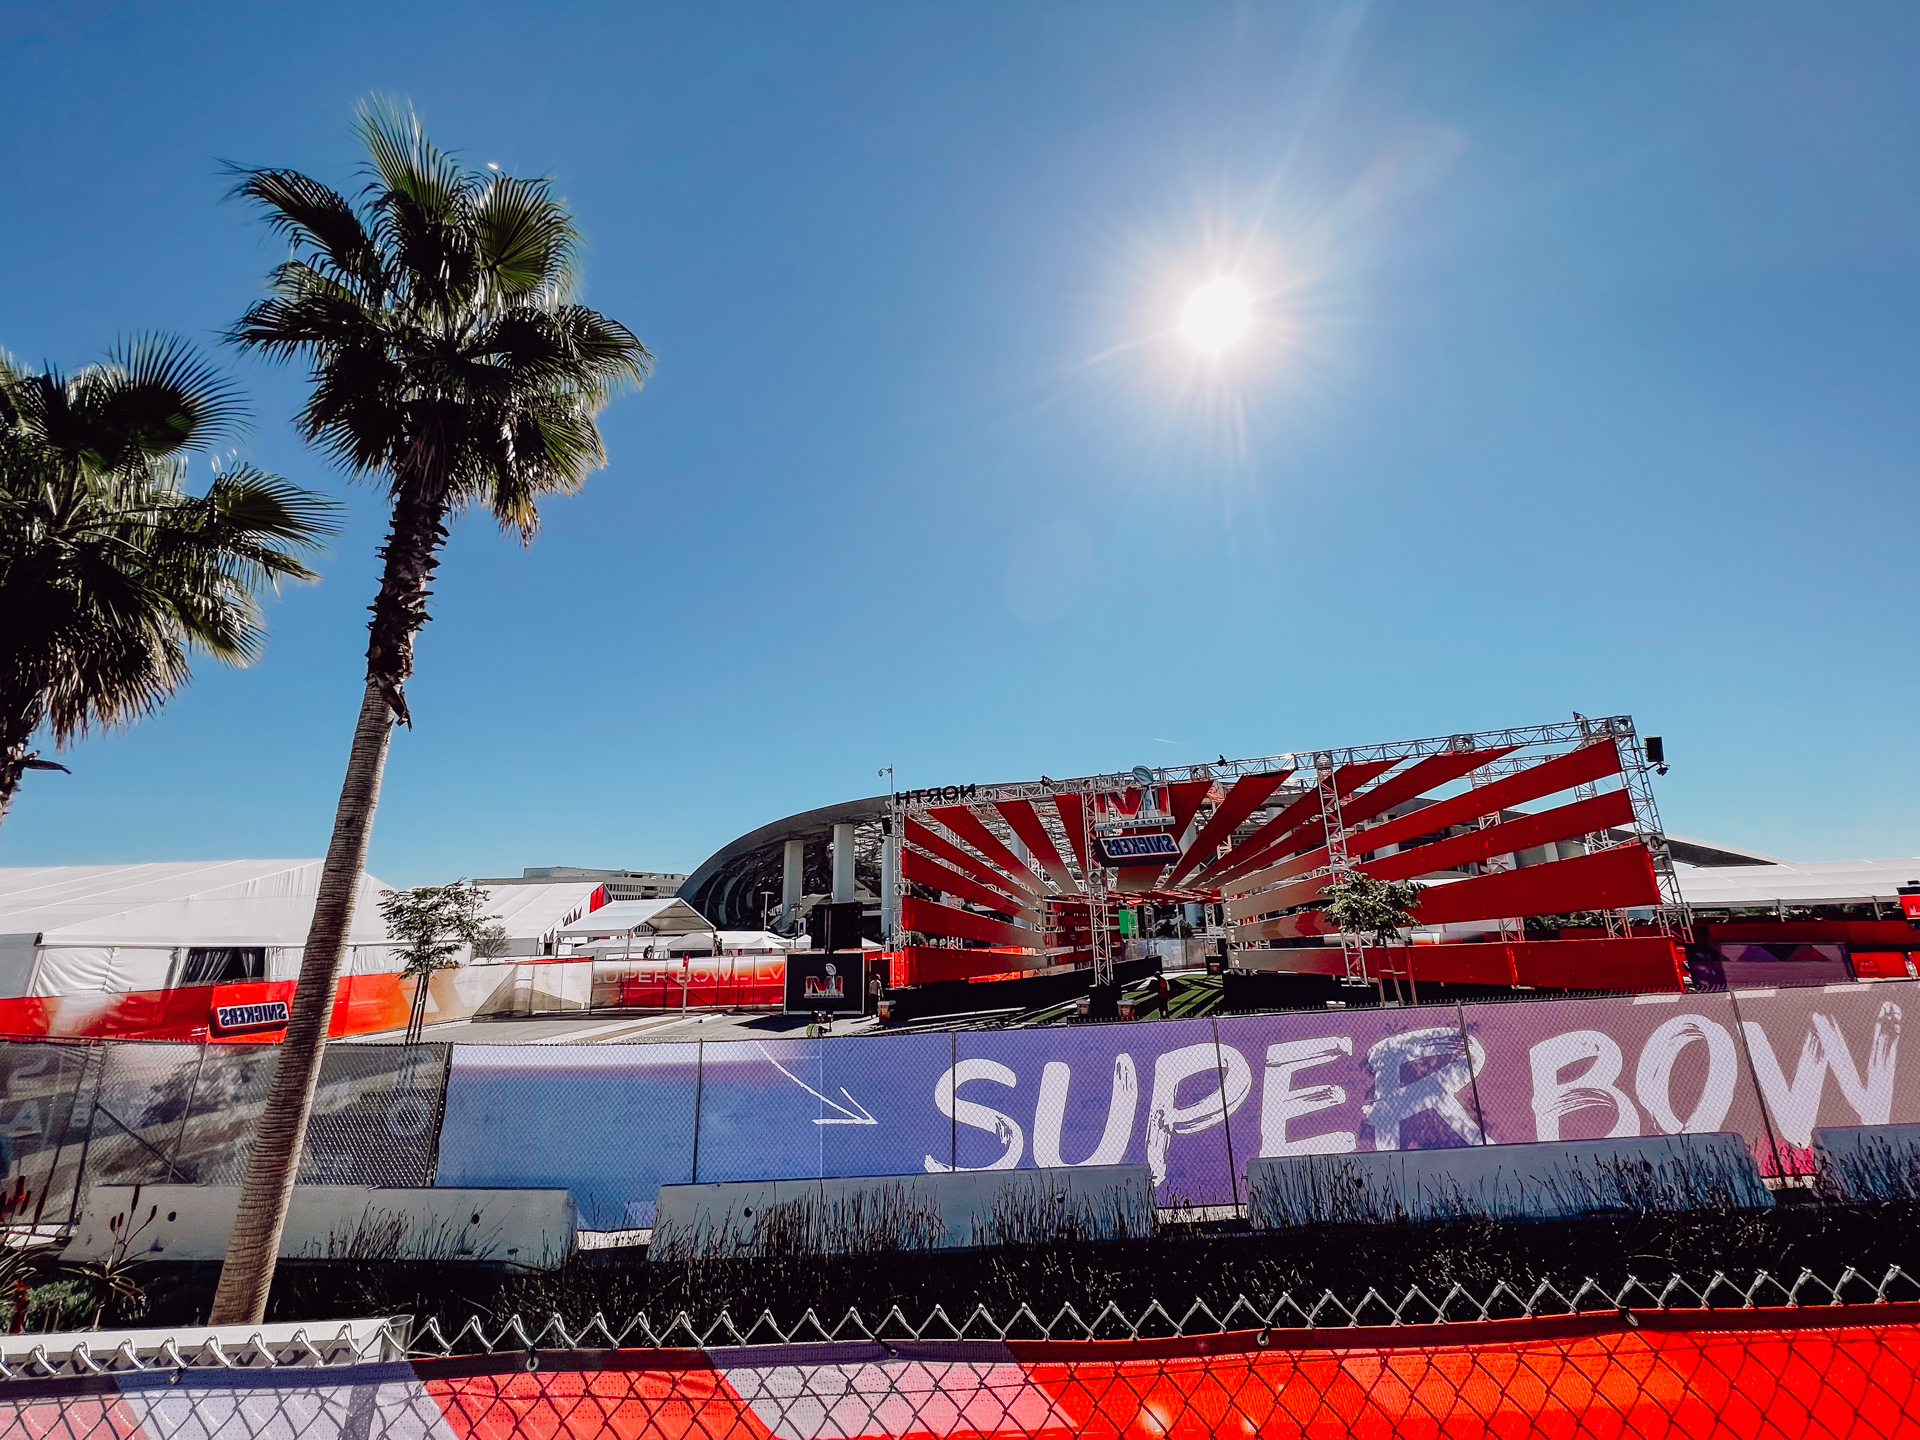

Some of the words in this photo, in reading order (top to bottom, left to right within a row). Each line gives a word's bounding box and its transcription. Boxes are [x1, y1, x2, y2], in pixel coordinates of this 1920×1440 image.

[593, 969, 669, 985] SUPER
[677, 967, 750, 984] BOWL
[924, 1027, 1497, 1187] SUPER
